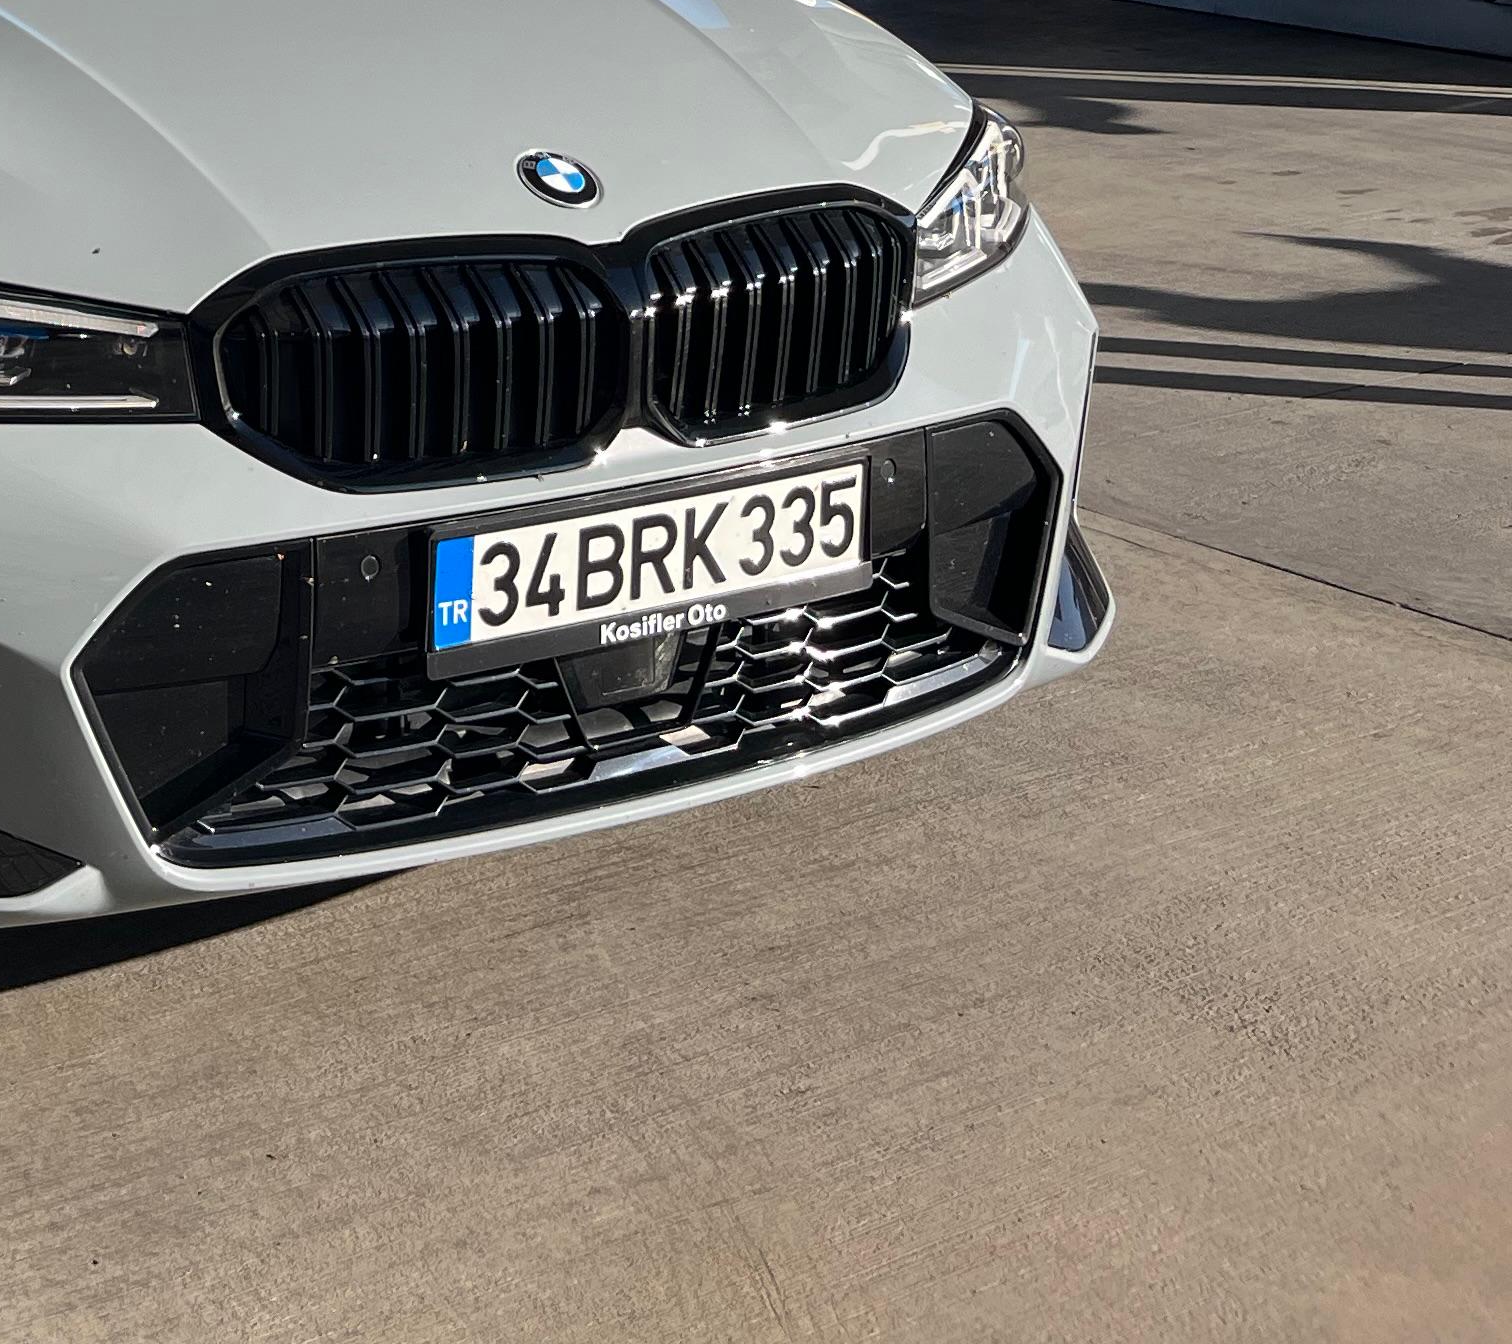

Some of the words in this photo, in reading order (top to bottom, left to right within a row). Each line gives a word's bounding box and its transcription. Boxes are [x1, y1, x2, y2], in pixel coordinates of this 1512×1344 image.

[738, 473, 858, 577] 335
[438, 597, 469, 627] TR
[599, 612, 685, 645] Kosifler
[687, 603, 728, 627] Oto
